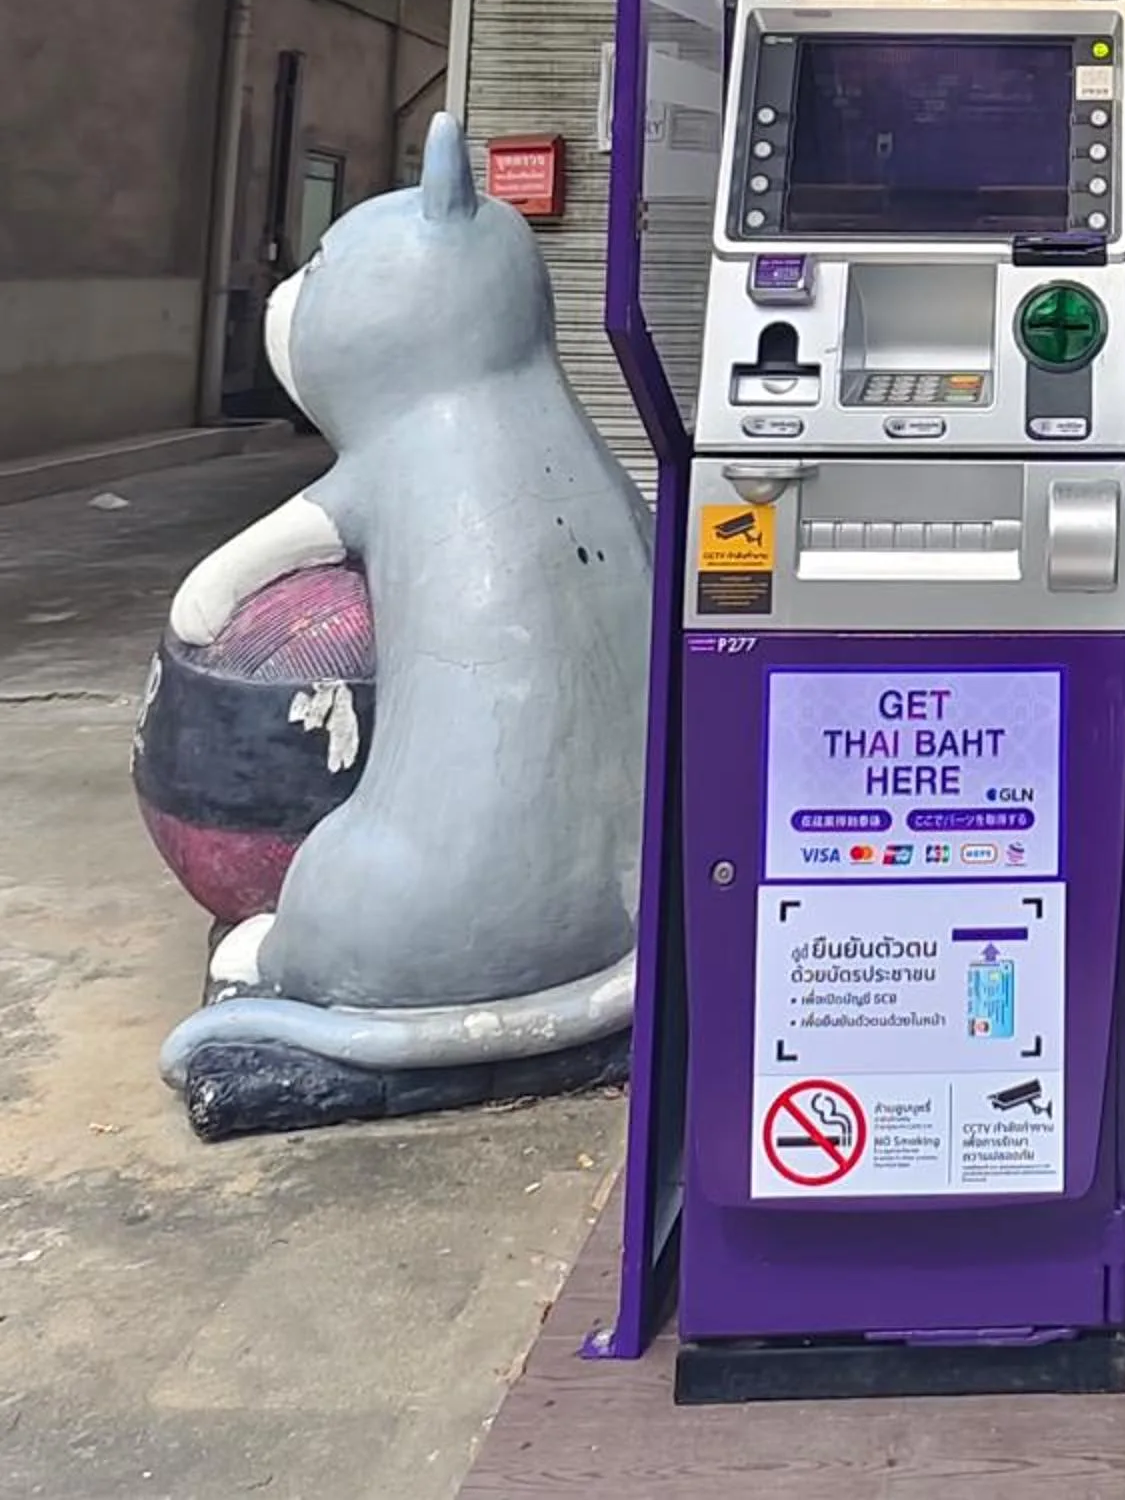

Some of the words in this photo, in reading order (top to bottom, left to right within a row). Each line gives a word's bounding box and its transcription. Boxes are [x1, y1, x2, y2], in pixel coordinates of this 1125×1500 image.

[717, 637, 757, 654] P277
[878, 689, 951, 721] GET
[823, 729, 899, 759] THAI
[915, 728, 1006, 758] BAHT
[865, 765, 961, 797] HERE
[998, 787, 1034, 802] GLN
[800, 847, 841, 864] VISA
[811, 935, 938, 960] ยืนยันตัวตน
[791, 964, 936, 984] ด้วยบัตรประชาชน
